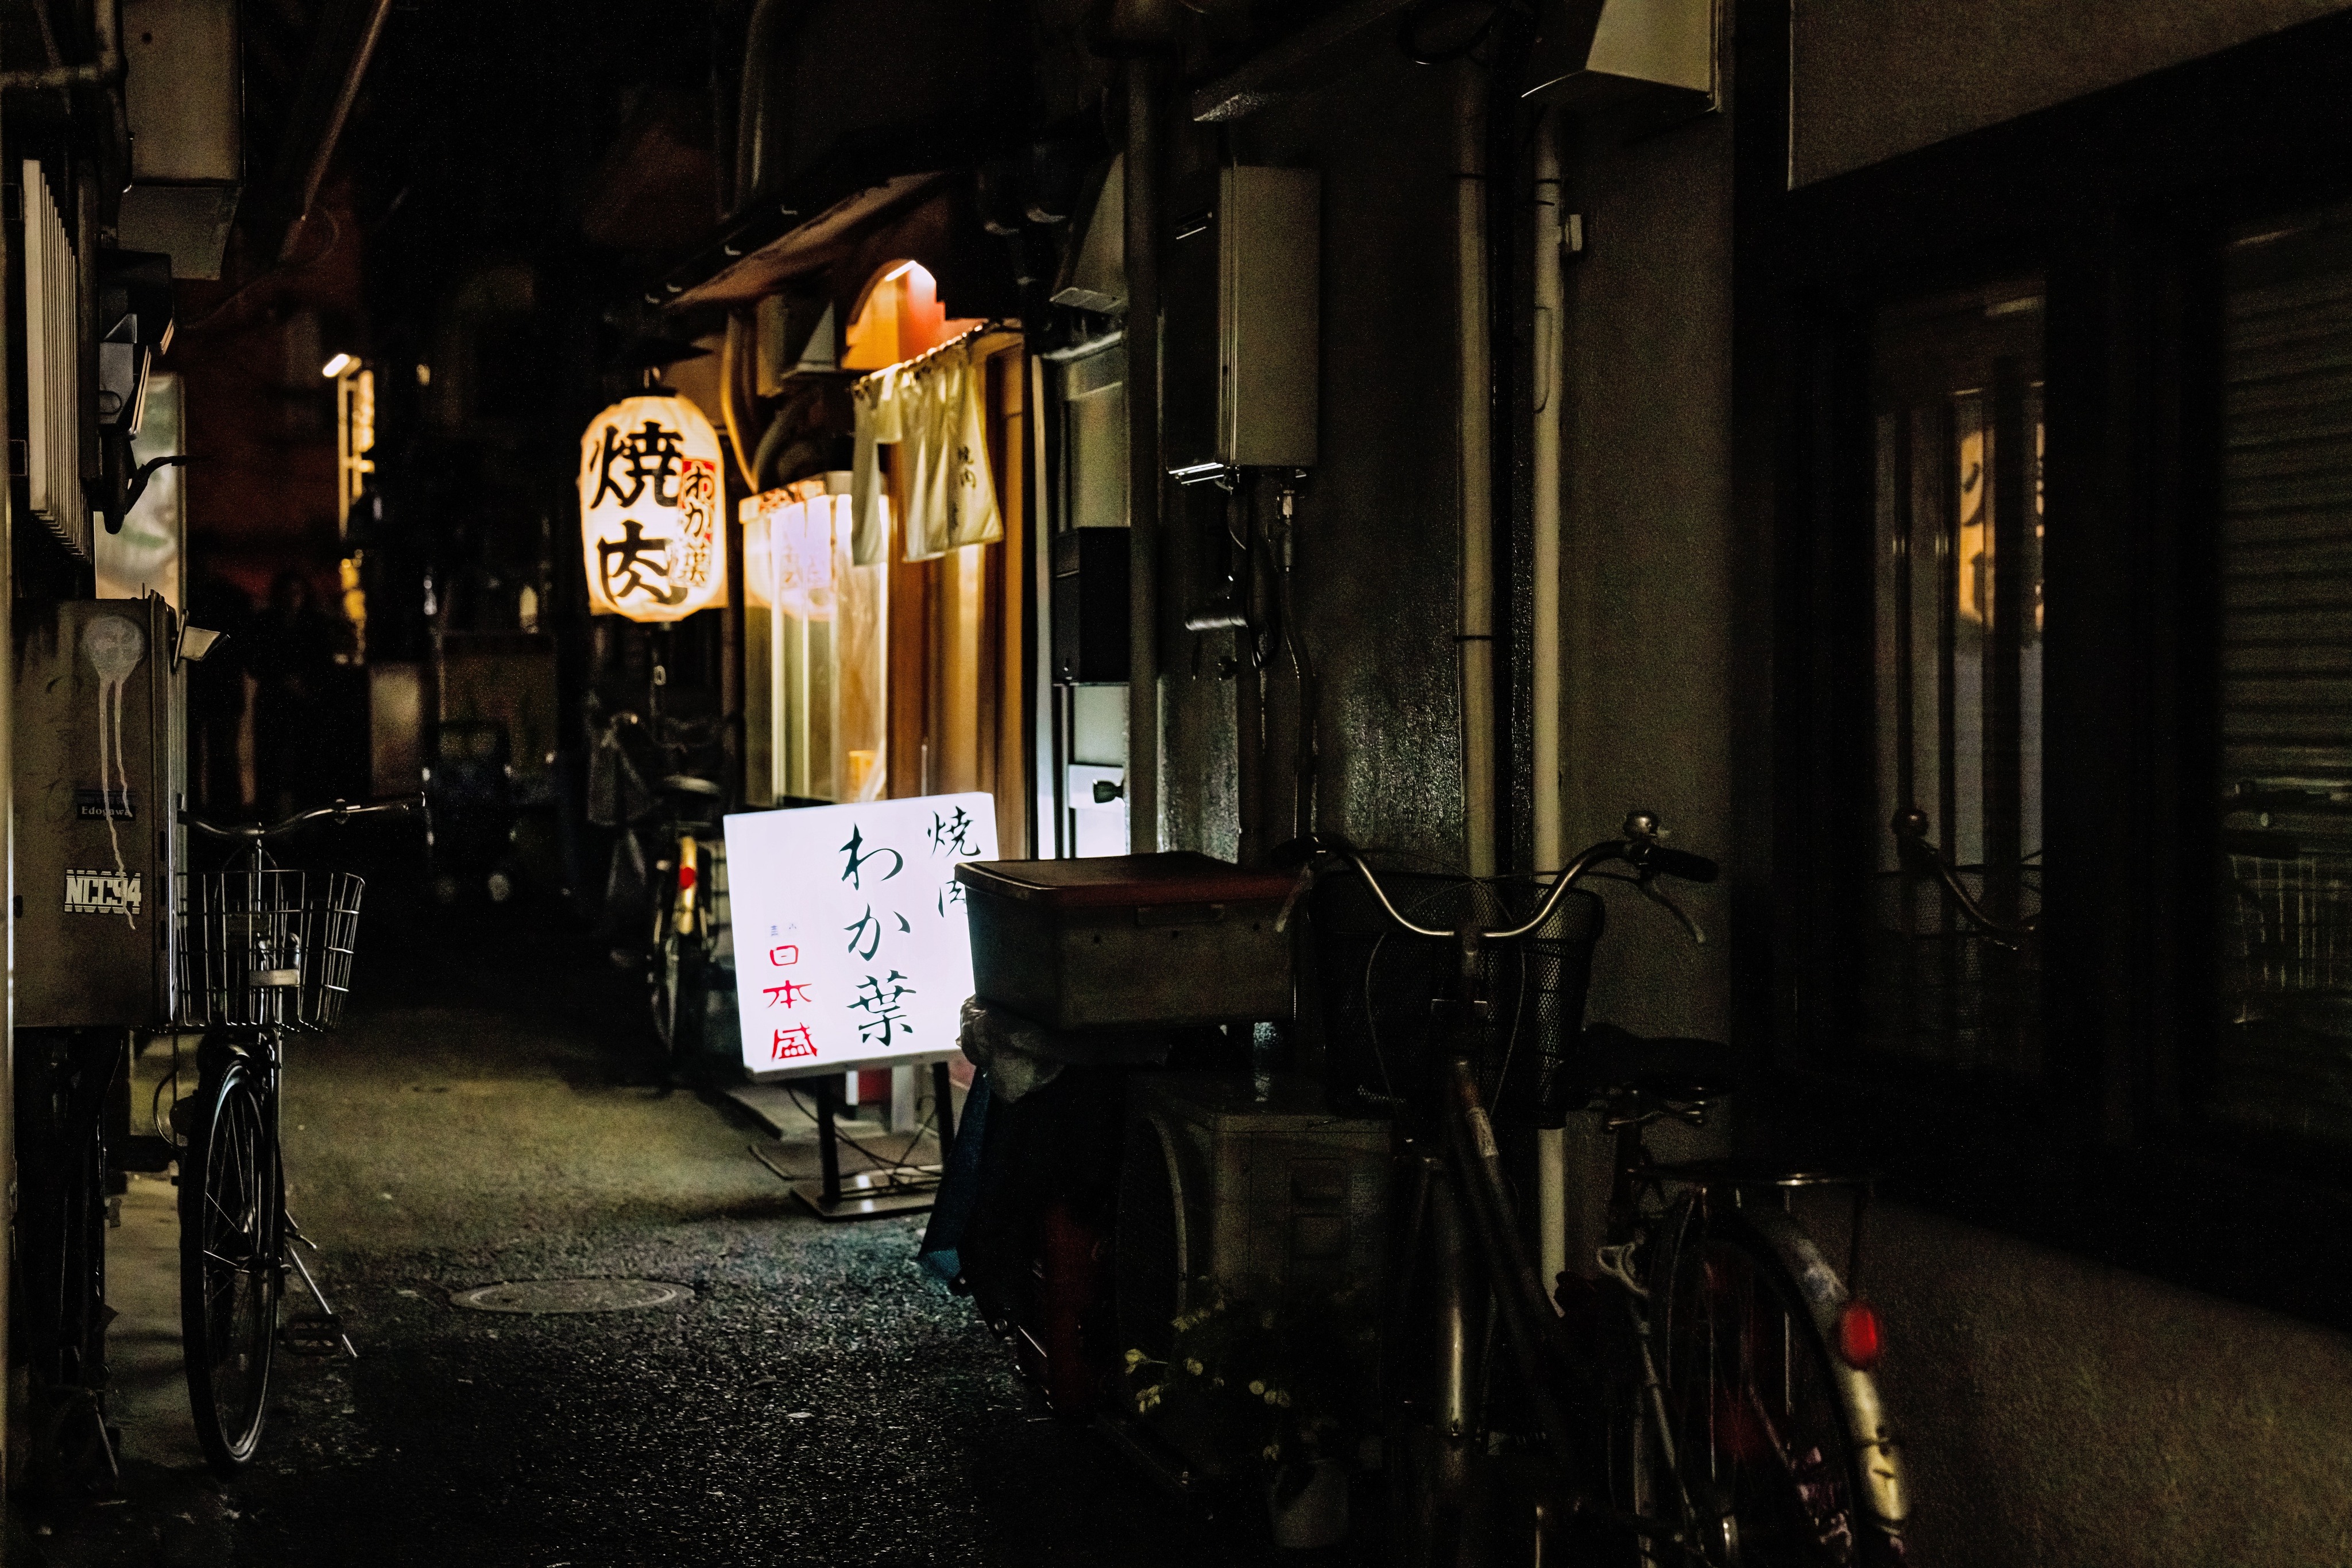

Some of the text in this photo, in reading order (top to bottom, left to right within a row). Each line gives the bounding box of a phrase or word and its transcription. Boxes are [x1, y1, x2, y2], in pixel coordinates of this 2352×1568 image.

[590, 421, 688, 606] 焼肉
[64, 869, 142, 915] NCC94
[839, 823, 916, 1047] わか葉
[763, 944, 818, 1062] 日本盛
